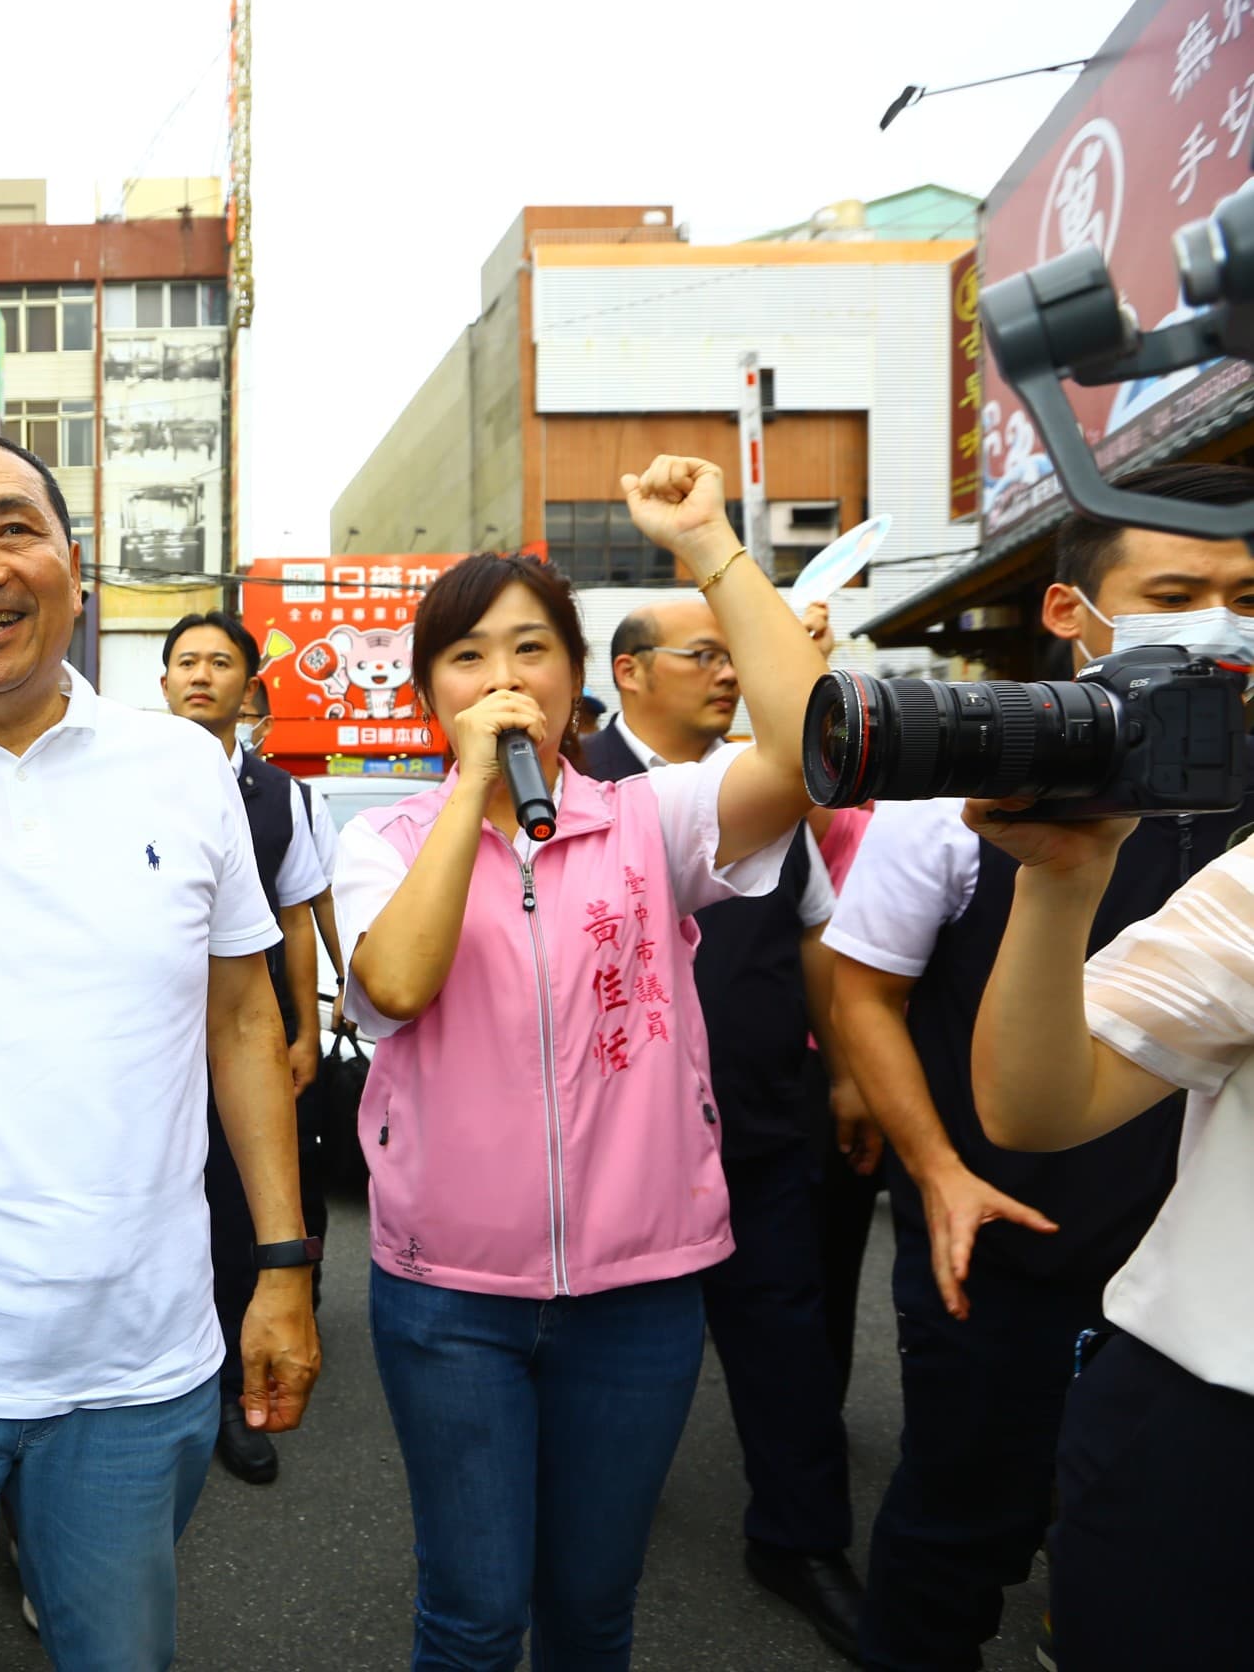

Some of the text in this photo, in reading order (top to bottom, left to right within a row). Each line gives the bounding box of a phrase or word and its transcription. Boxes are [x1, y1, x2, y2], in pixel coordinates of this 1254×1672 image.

[332, 565, 446, 600] 日藥本
[582, 898, 630, 1077] 黃佳恬
[623, 865, 670, 1043] 臺中市議員
